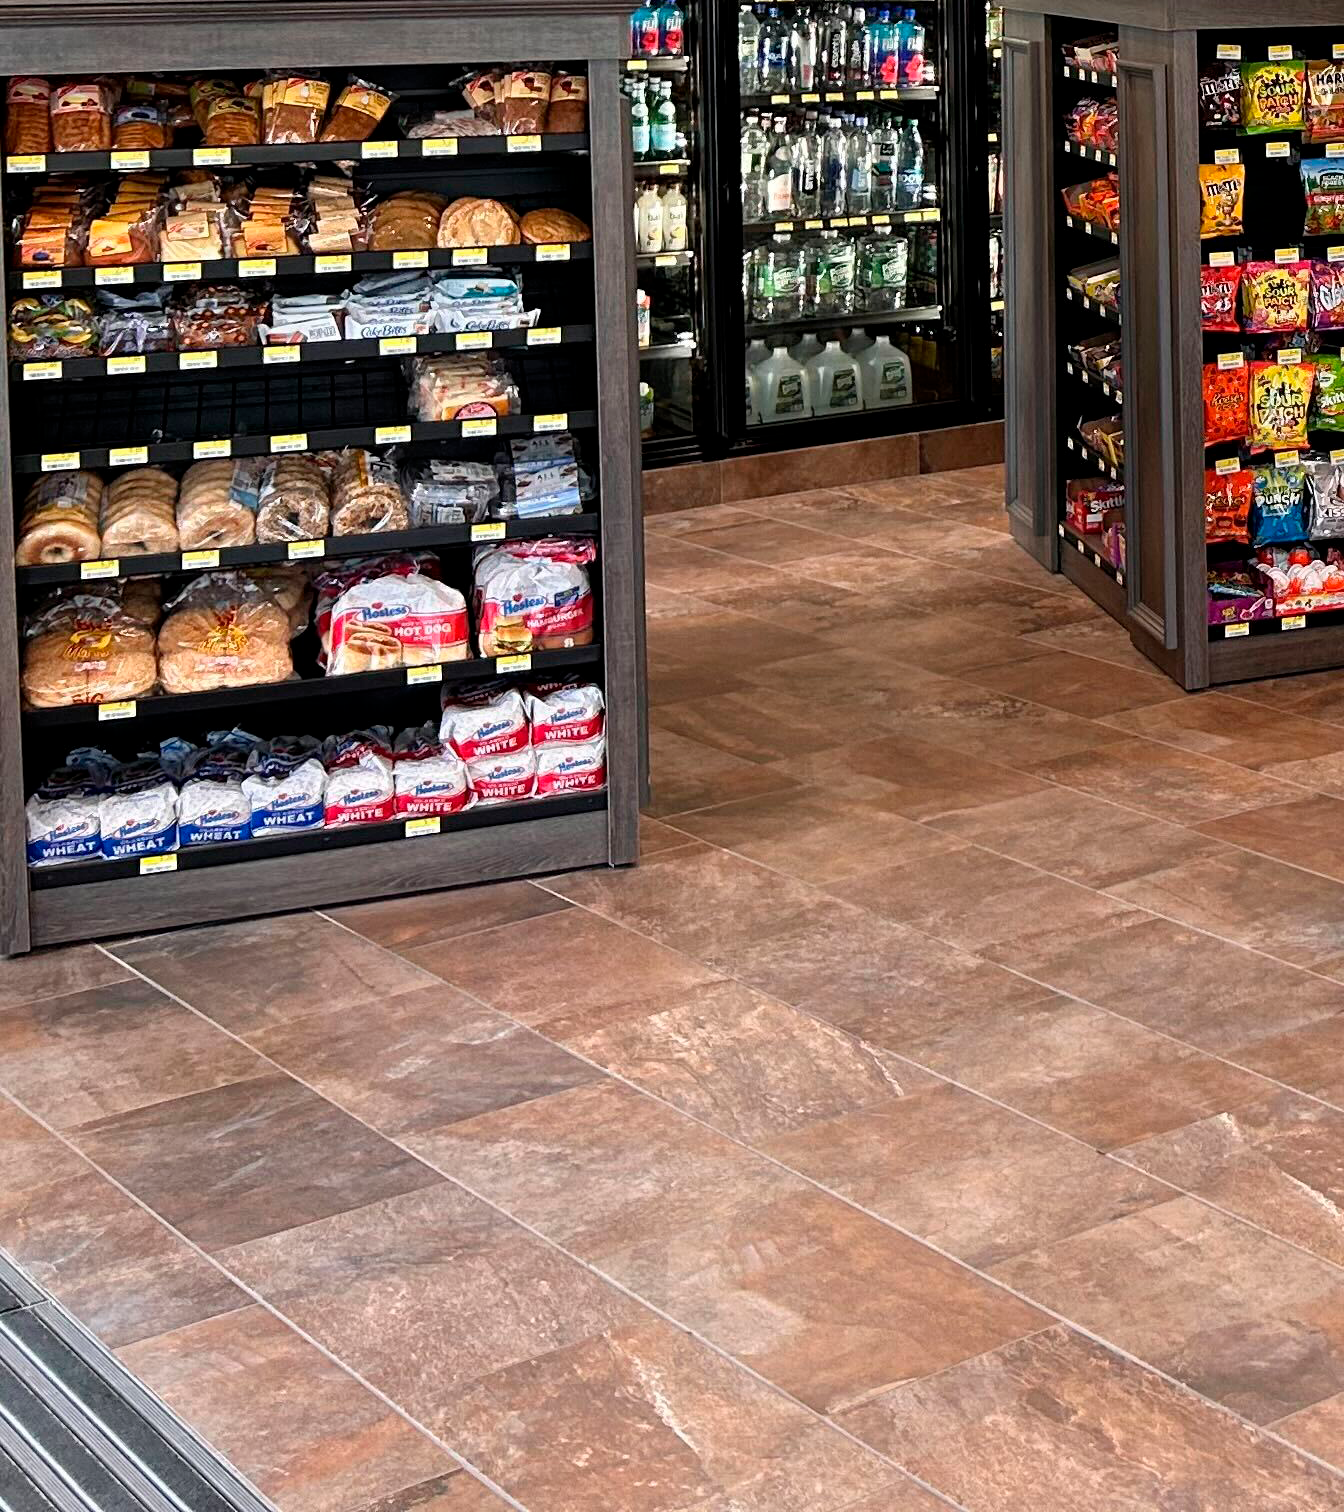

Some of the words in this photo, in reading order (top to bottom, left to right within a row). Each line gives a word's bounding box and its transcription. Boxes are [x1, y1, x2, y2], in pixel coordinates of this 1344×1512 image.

[1258, 83, 1296, 97] SOUR
[1258, 94, 1299, 110] PATCH
[1264, 288, 1296, 298] SOUR
[1263, 296, 1298, 306] PATCH
[1259, 393, 1302, 408] SOUR
[1254, 492, 1300, 507] PUNCH
[361, 605, 407, 621] Hostess
[503, 595, 546, 616] Hostess
[527, 608, 584, 628] HAMBURGER
[394, 626, 423, 637] HOT
[425, 622, 452, 635] DOG
[544, 724, 589, 740] WHITE
[473, 738, 518, 756] WHITE
[552, 774, 597, 790] WHITE
[481, 783, 526, 798] WHITE
[406, 801, 452, 813] WHITE
[263, 811, 315, 826] WHEAT
[337, 808, 384, 822] WHITE
[190, 829, 242, 841] WHEAT
[42, 840, 96, 858] WHEAT
[112, 836, 165, 856] WHEAT
